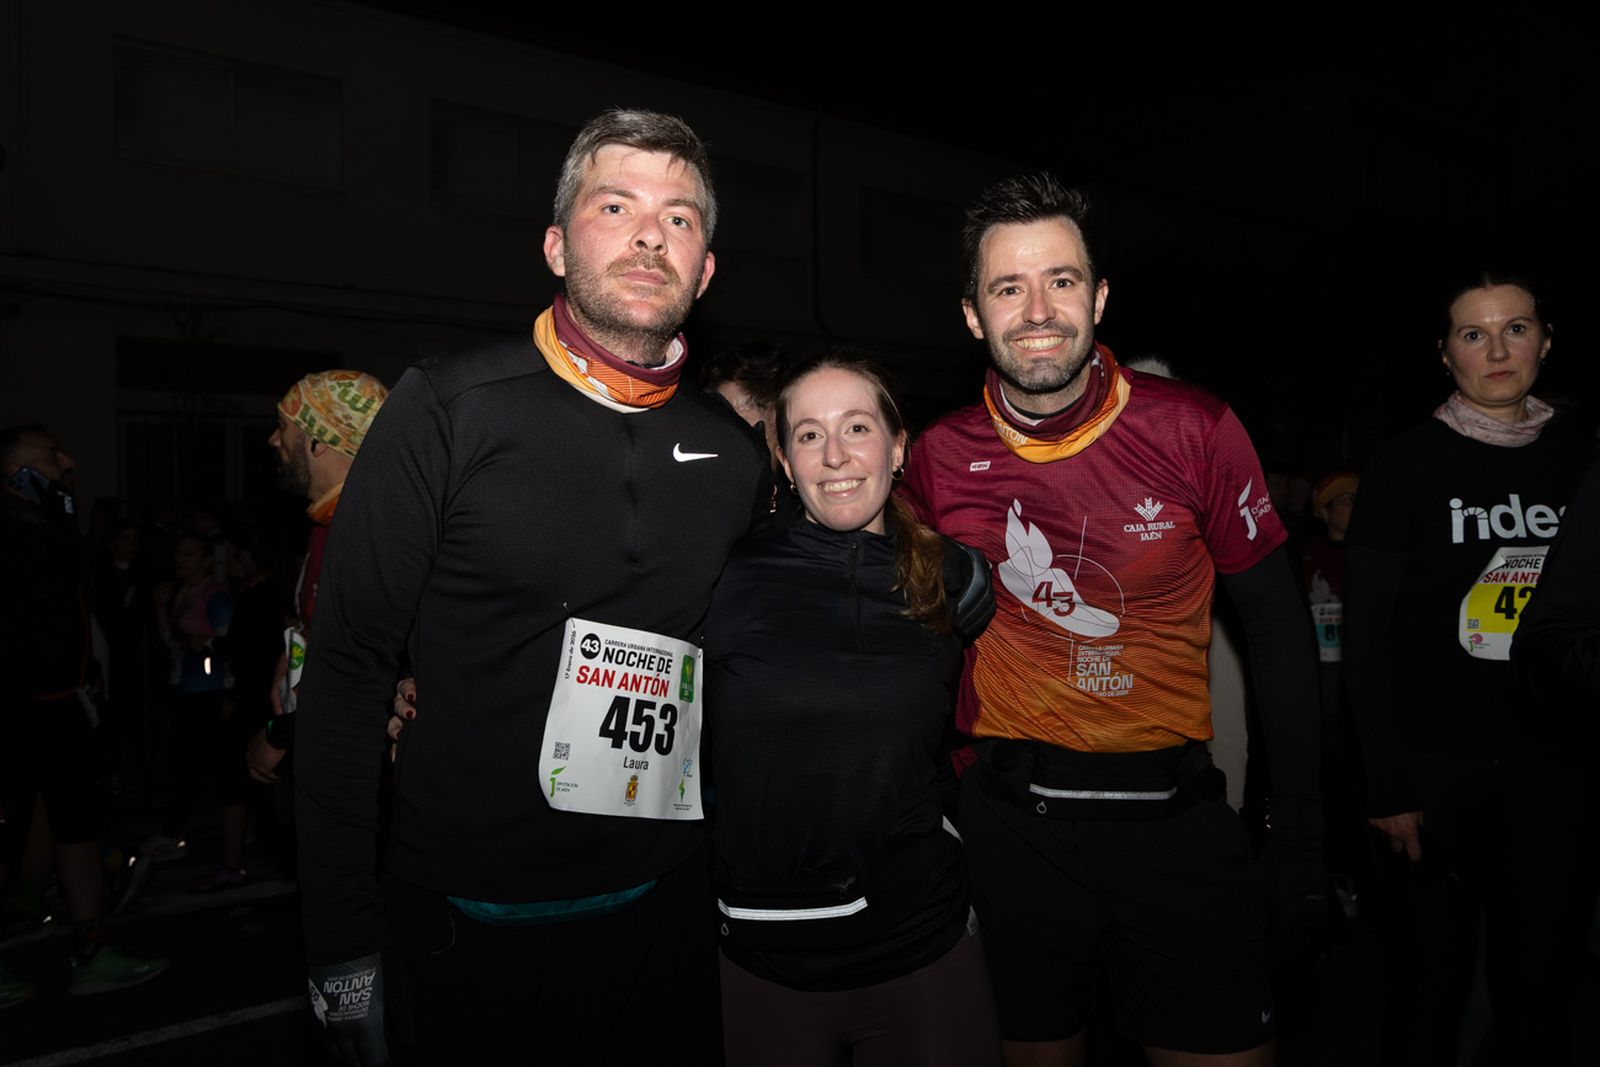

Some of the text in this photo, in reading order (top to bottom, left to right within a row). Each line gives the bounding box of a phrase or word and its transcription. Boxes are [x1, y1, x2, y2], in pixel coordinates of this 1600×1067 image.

[1147, 520, 1176, 531] RURAL
[1448, 492, 1567, 545] inde
[1502, 558, 1541, 569] NOCHE
[1483, 571, 1510, 584] SAN
[1032, 580, 1076, 617] 43
[581, 638, 601, 653] 43
[604, 638, 674, 658] CARRERA URBANA INTERNACIONAL
[602, 646, 673, 675] NOCHE DE
[1076, 661, 1112, 677] SAN
[576, 665, 616, 689] SAN
[617, 672, 671, 699] ANTÓN
[1076, 672, 1134, 692] ANTÓN
[599, 694, 678, 756] 453
[623, 756, 649, 771] Laura
[322, 970, 377, 997] ANTÓN
[339, 986, 373, 1006] SAN
